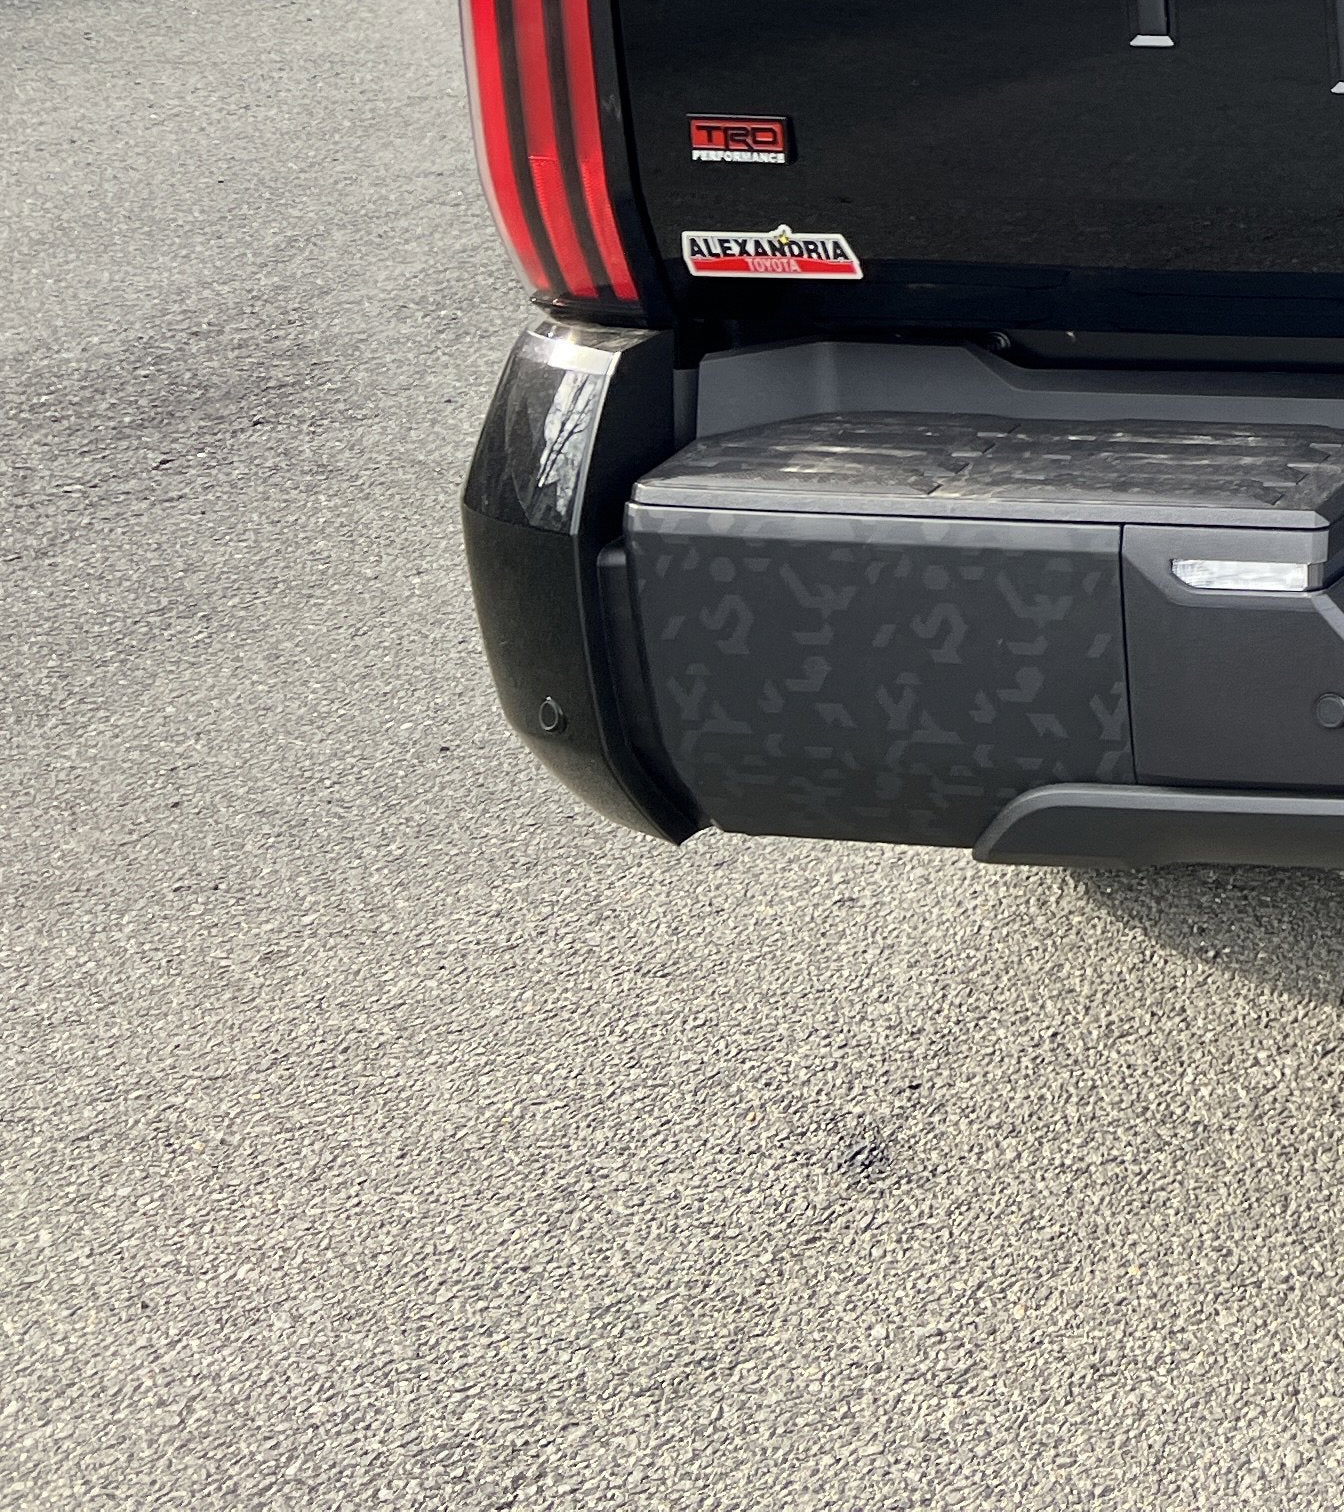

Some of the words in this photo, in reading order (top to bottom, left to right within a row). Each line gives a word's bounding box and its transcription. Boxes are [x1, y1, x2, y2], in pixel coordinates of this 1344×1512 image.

[695, 124, 779, 152] TRD
[692, 150, 785, 163] PERFORMANCE
[689, 238, 849, 261] ALEXANDRIA
[746, 258, 801, 273] TOYOTA
